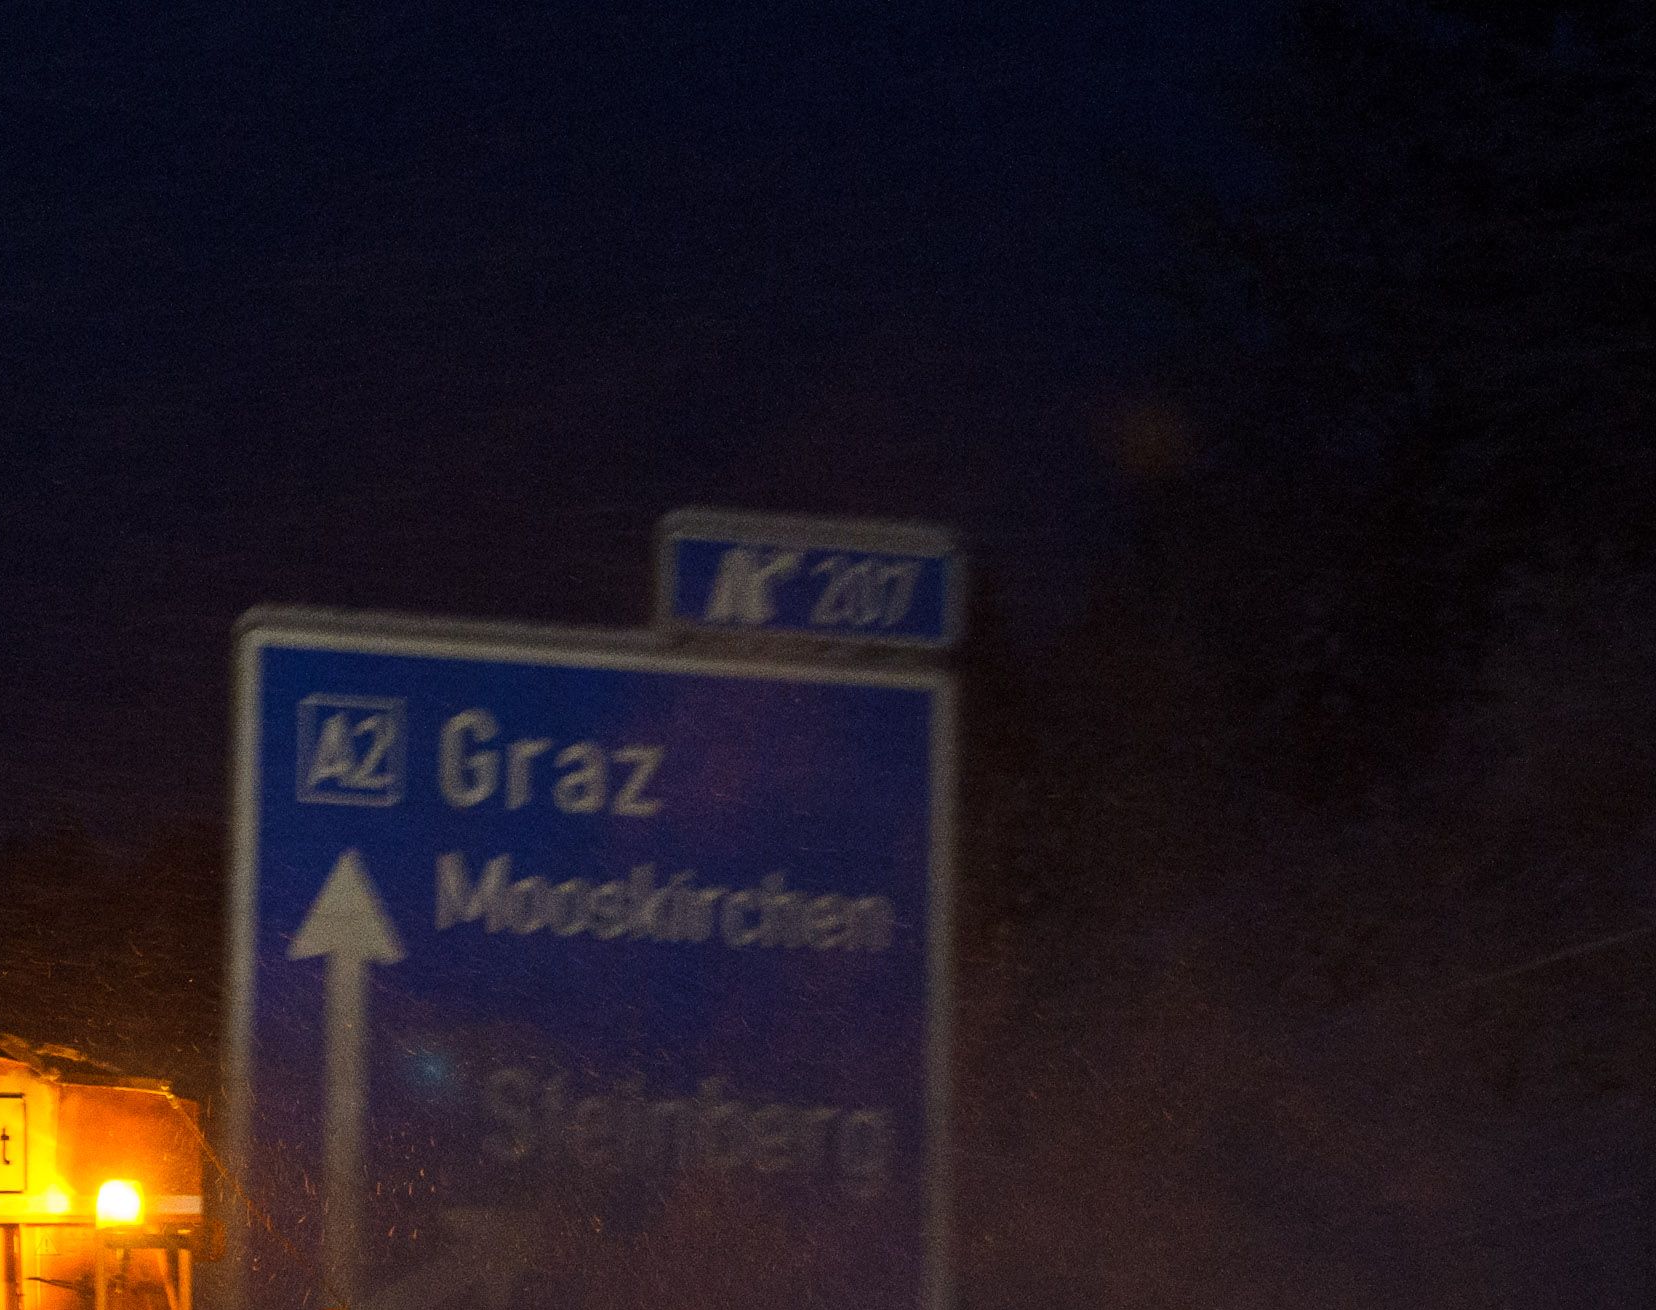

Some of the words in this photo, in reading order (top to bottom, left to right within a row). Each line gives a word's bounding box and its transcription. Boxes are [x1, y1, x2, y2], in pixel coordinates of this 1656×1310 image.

[307, 710, 397, 790] A2
[440, 708, 667, 817] Graz
[435, 850, 897, 950] Mooskirchen
